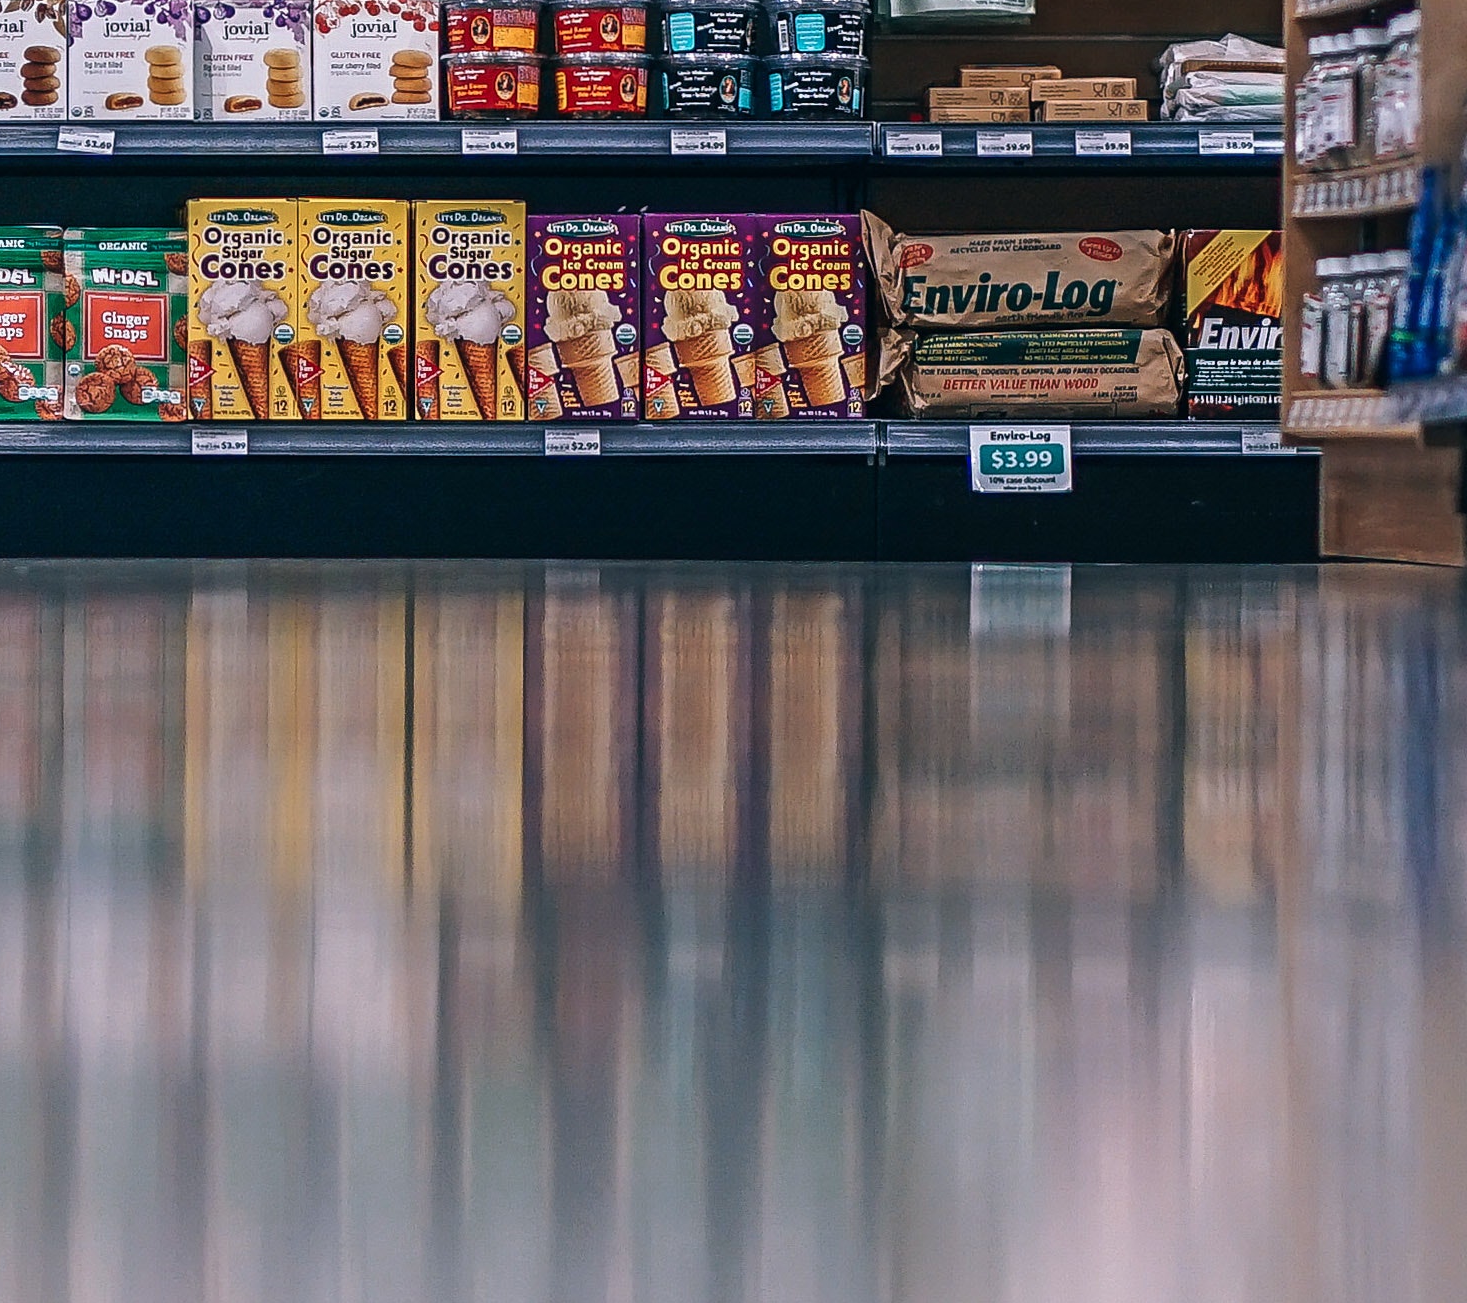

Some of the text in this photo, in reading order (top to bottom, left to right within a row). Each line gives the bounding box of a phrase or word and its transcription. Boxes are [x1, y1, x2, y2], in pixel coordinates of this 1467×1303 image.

[102, 19, 151, 39] jovial
[431, 227, 511, 251] Organic
[662, 238, 740, 259] Organic
[450, 245, 492, 264] Sugar
[680, 258, 742, 271] Ice Cream
[427, 255, 513, 281] Cones
[659, 267, 743, 292] Cones
[902, 271, 1117, 316] Enviro-Log
[1199, 318, 1283, 350] Envir
[943, 378, 1099, 390] BETTER VALUE THAN WOOD
[571, 442, 599, 451] $2.99
[990, 430, 1052, 443] Enviro-Log
[991, 449, 1053, 469] $3.99
[988, 476, 1003, 484] 10%
[1024, 476, 1056, 484] discount
